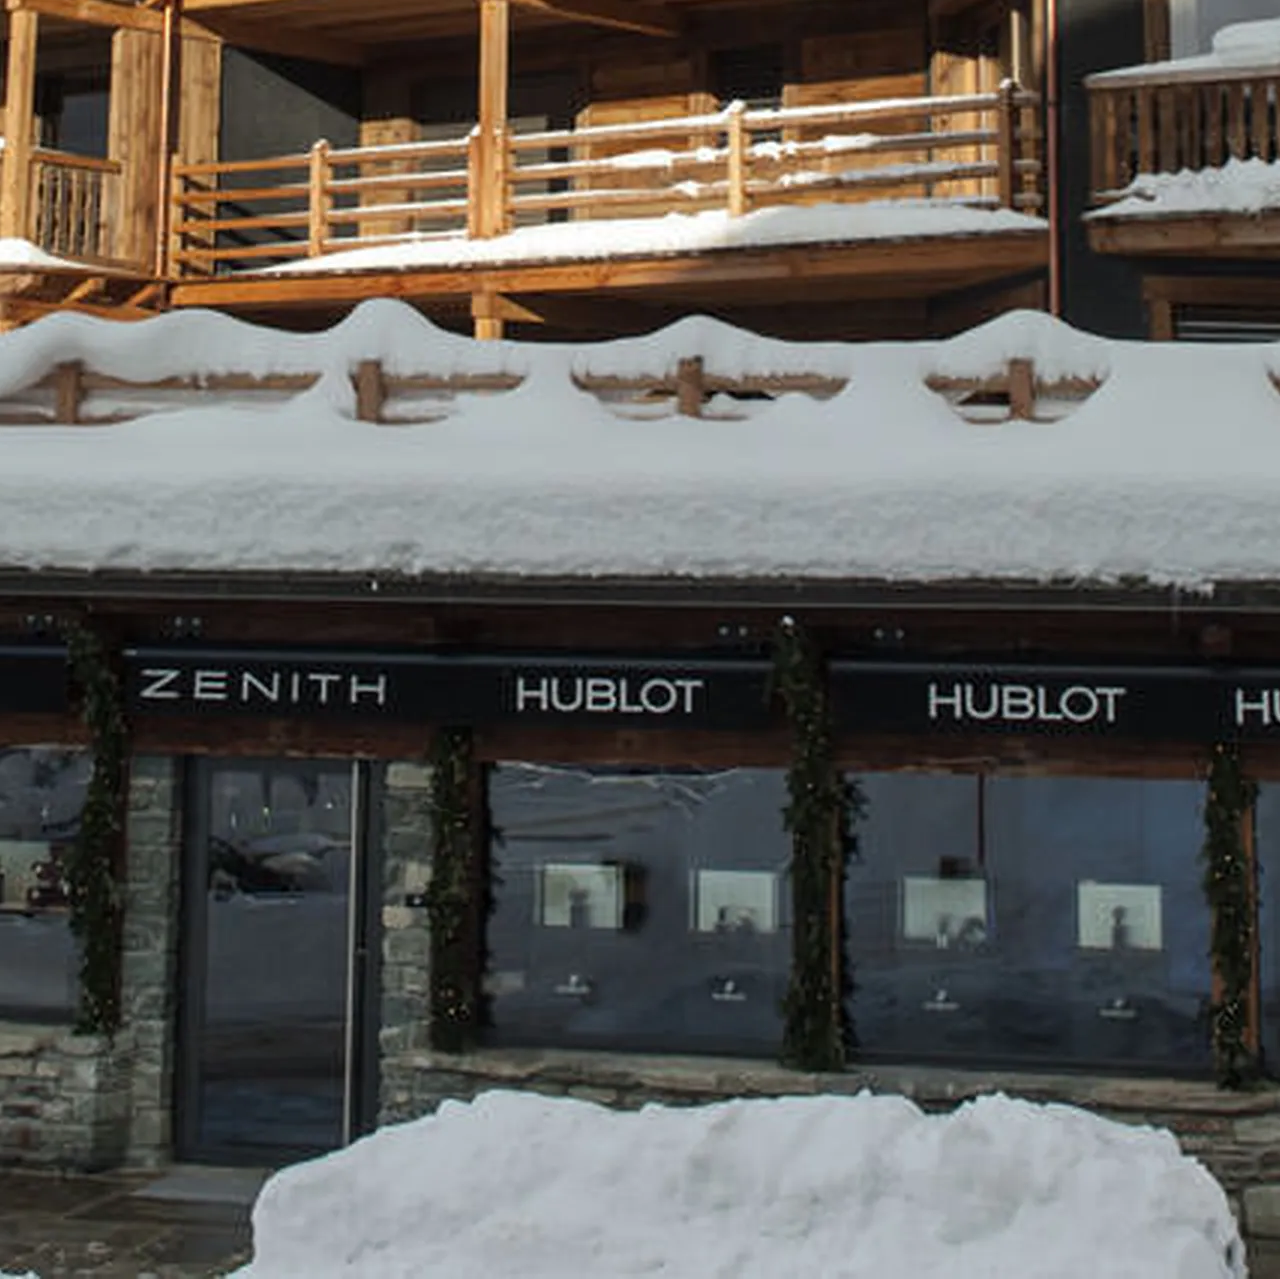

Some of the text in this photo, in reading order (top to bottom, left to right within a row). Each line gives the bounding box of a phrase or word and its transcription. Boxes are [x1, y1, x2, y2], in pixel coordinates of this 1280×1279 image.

[140, 669, 387, 705] ZENITH
[517, 677, 704, 713] HUBLOT
[928, 683, 1126, 722] HUBLOT
